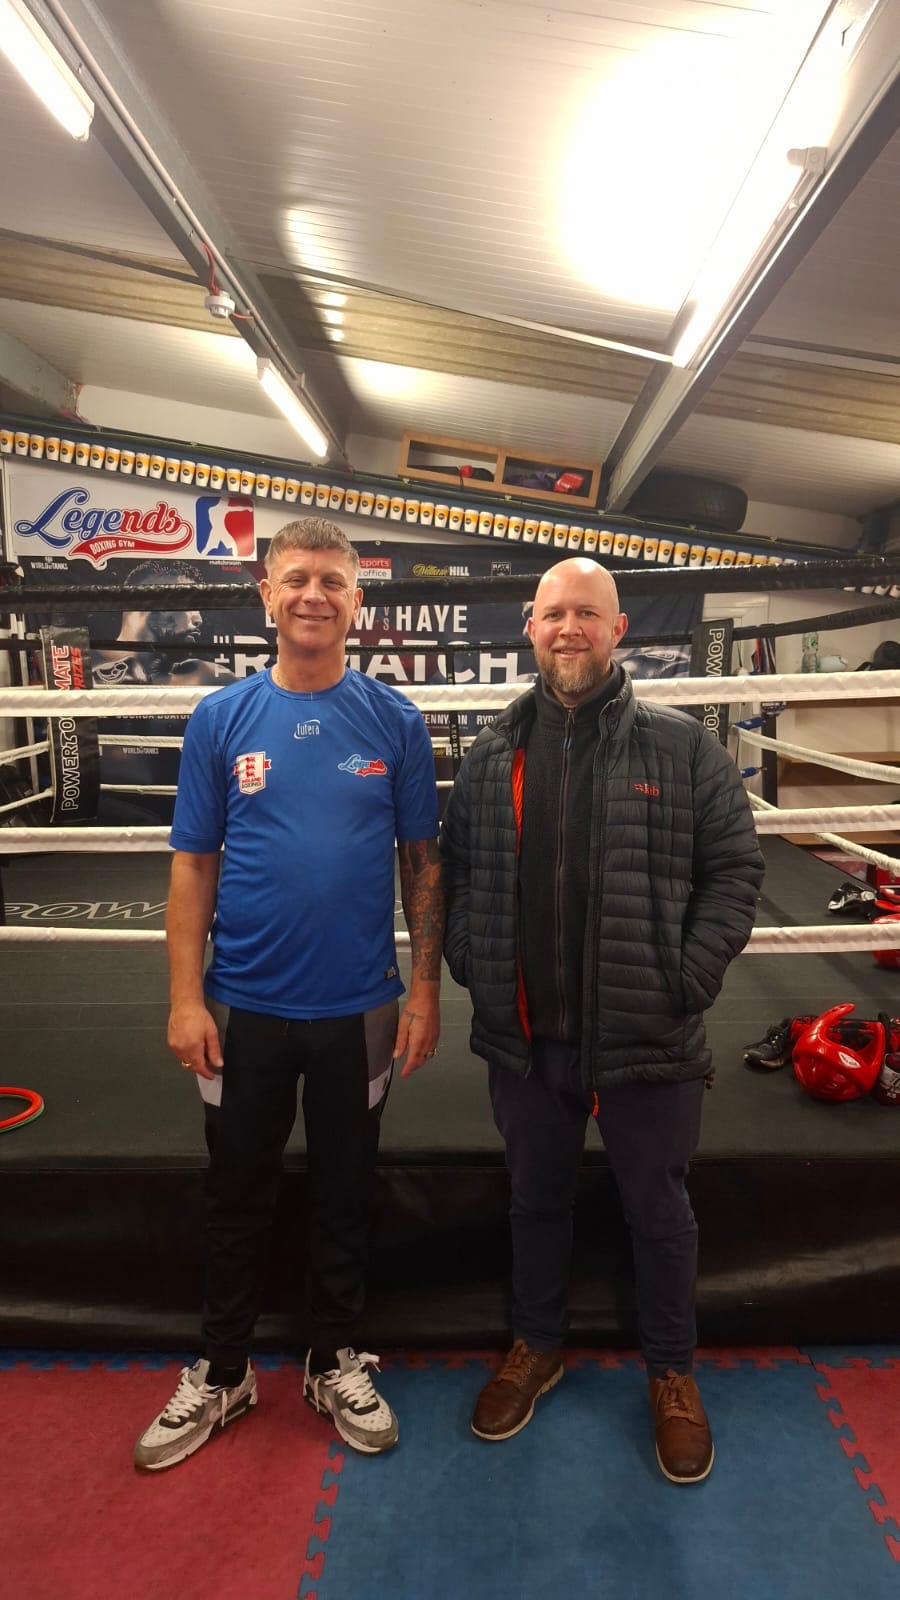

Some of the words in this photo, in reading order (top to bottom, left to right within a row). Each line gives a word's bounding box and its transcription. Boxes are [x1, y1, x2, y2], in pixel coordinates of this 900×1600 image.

[14, 487, 184, 547] Legends
[89, 540, 116, 555] BOXING
[118, 540, 135, 548] GYM
[361, 559, 389, 568] sports
[449, 566, 470, 576] HILL
[396, 605, 468, 632] HAYE
